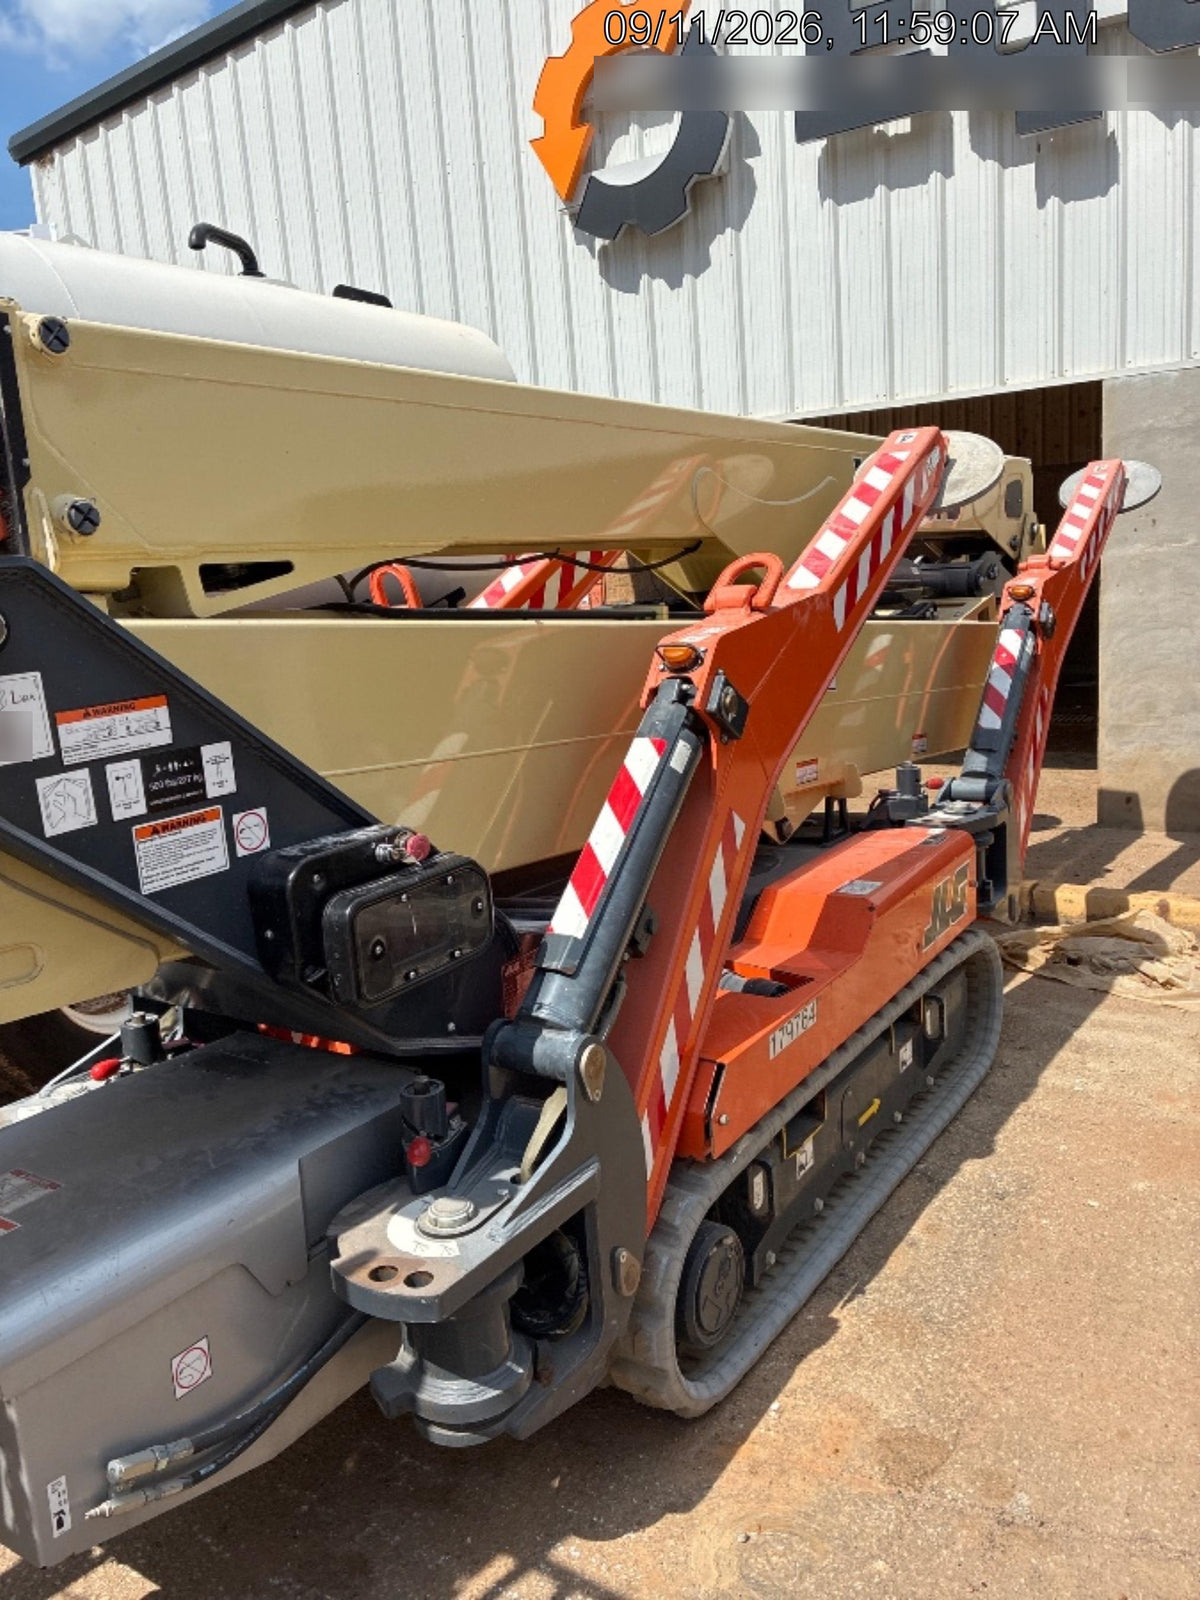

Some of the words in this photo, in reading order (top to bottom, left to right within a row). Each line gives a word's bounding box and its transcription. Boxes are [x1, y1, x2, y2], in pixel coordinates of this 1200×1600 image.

[92, 703, 136, 716] WARNING
[163, 814, 206, 832] WARNING
[923, 860, 970, 953] JLG
